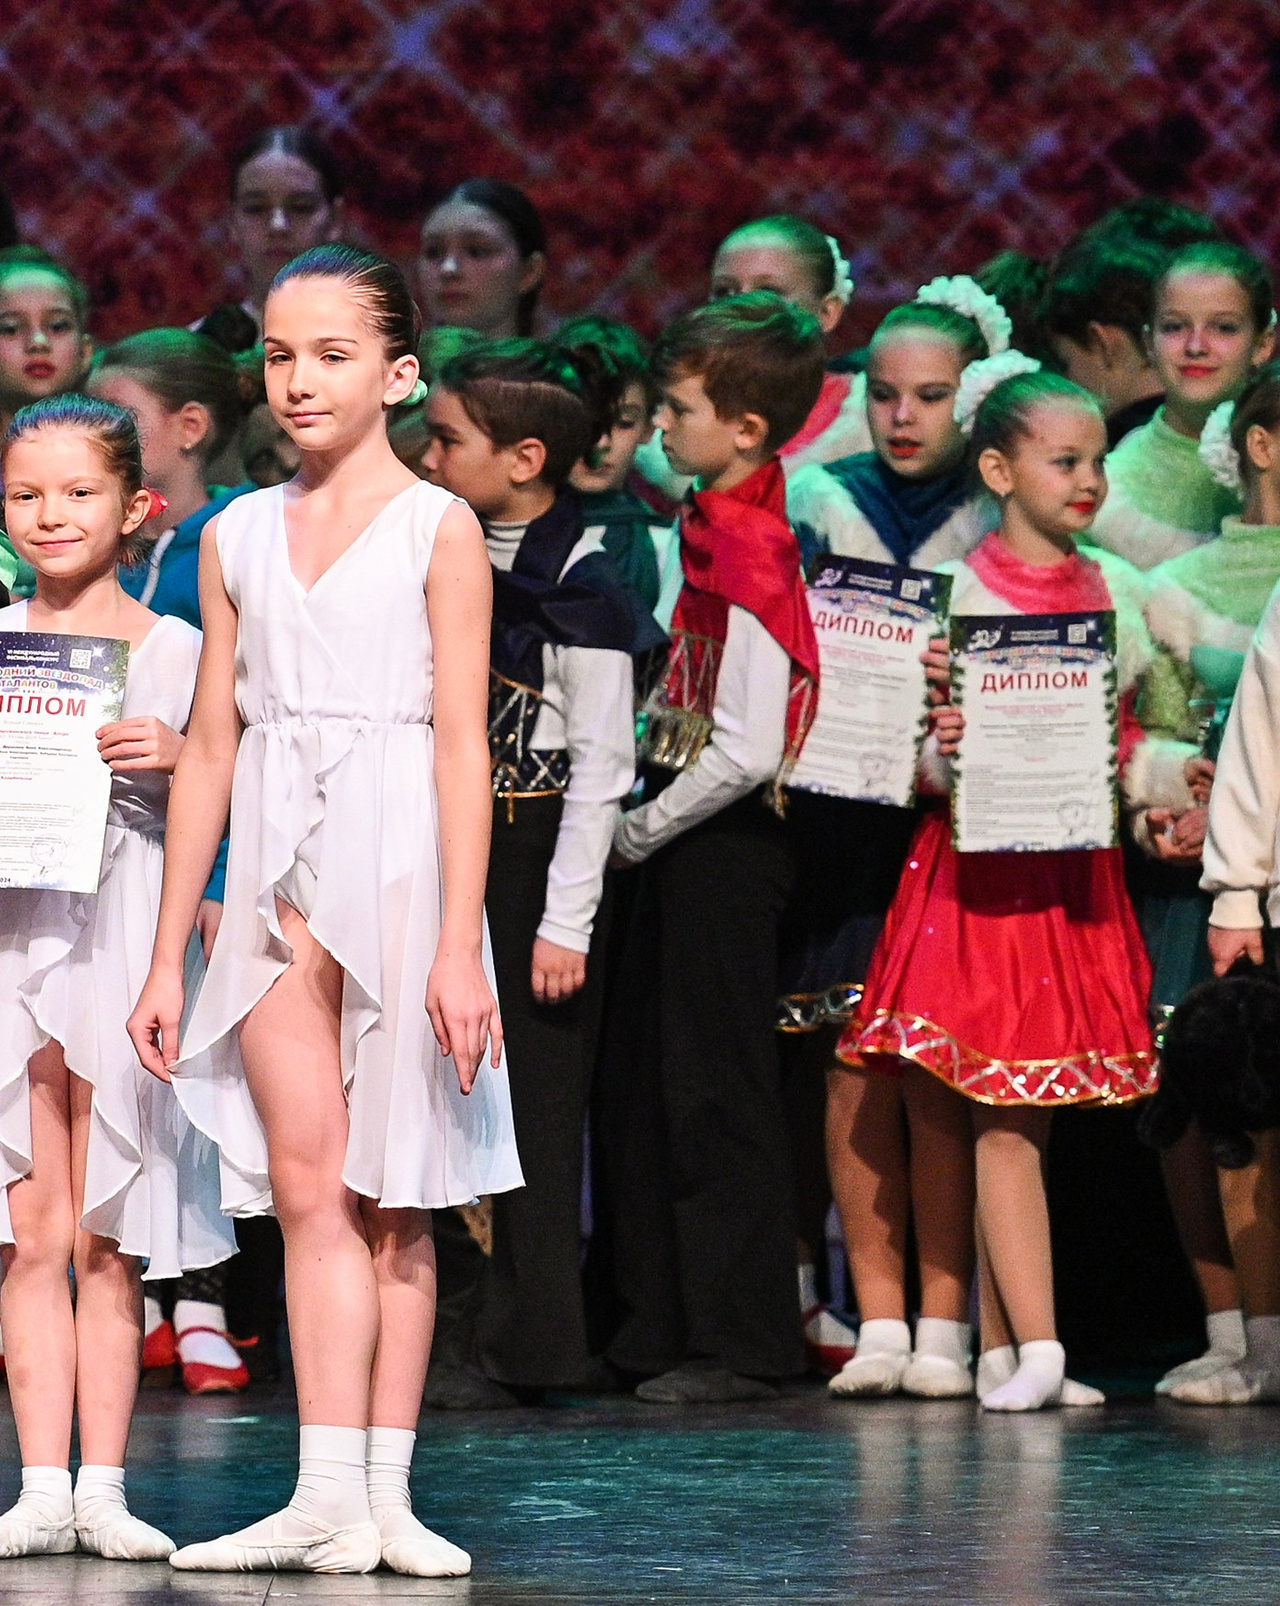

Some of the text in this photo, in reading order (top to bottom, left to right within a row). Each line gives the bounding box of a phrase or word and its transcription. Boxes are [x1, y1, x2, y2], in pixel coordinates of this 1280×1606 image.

[813, 610, 915, 644] ДИПЛОМ
[1, 680, 57, 689] ТАЛАНТОВ
[39, 670, 103, 689] ЗВЕЗДОПАД
[981, 671, 1088, 692] ДИПЛОМ
